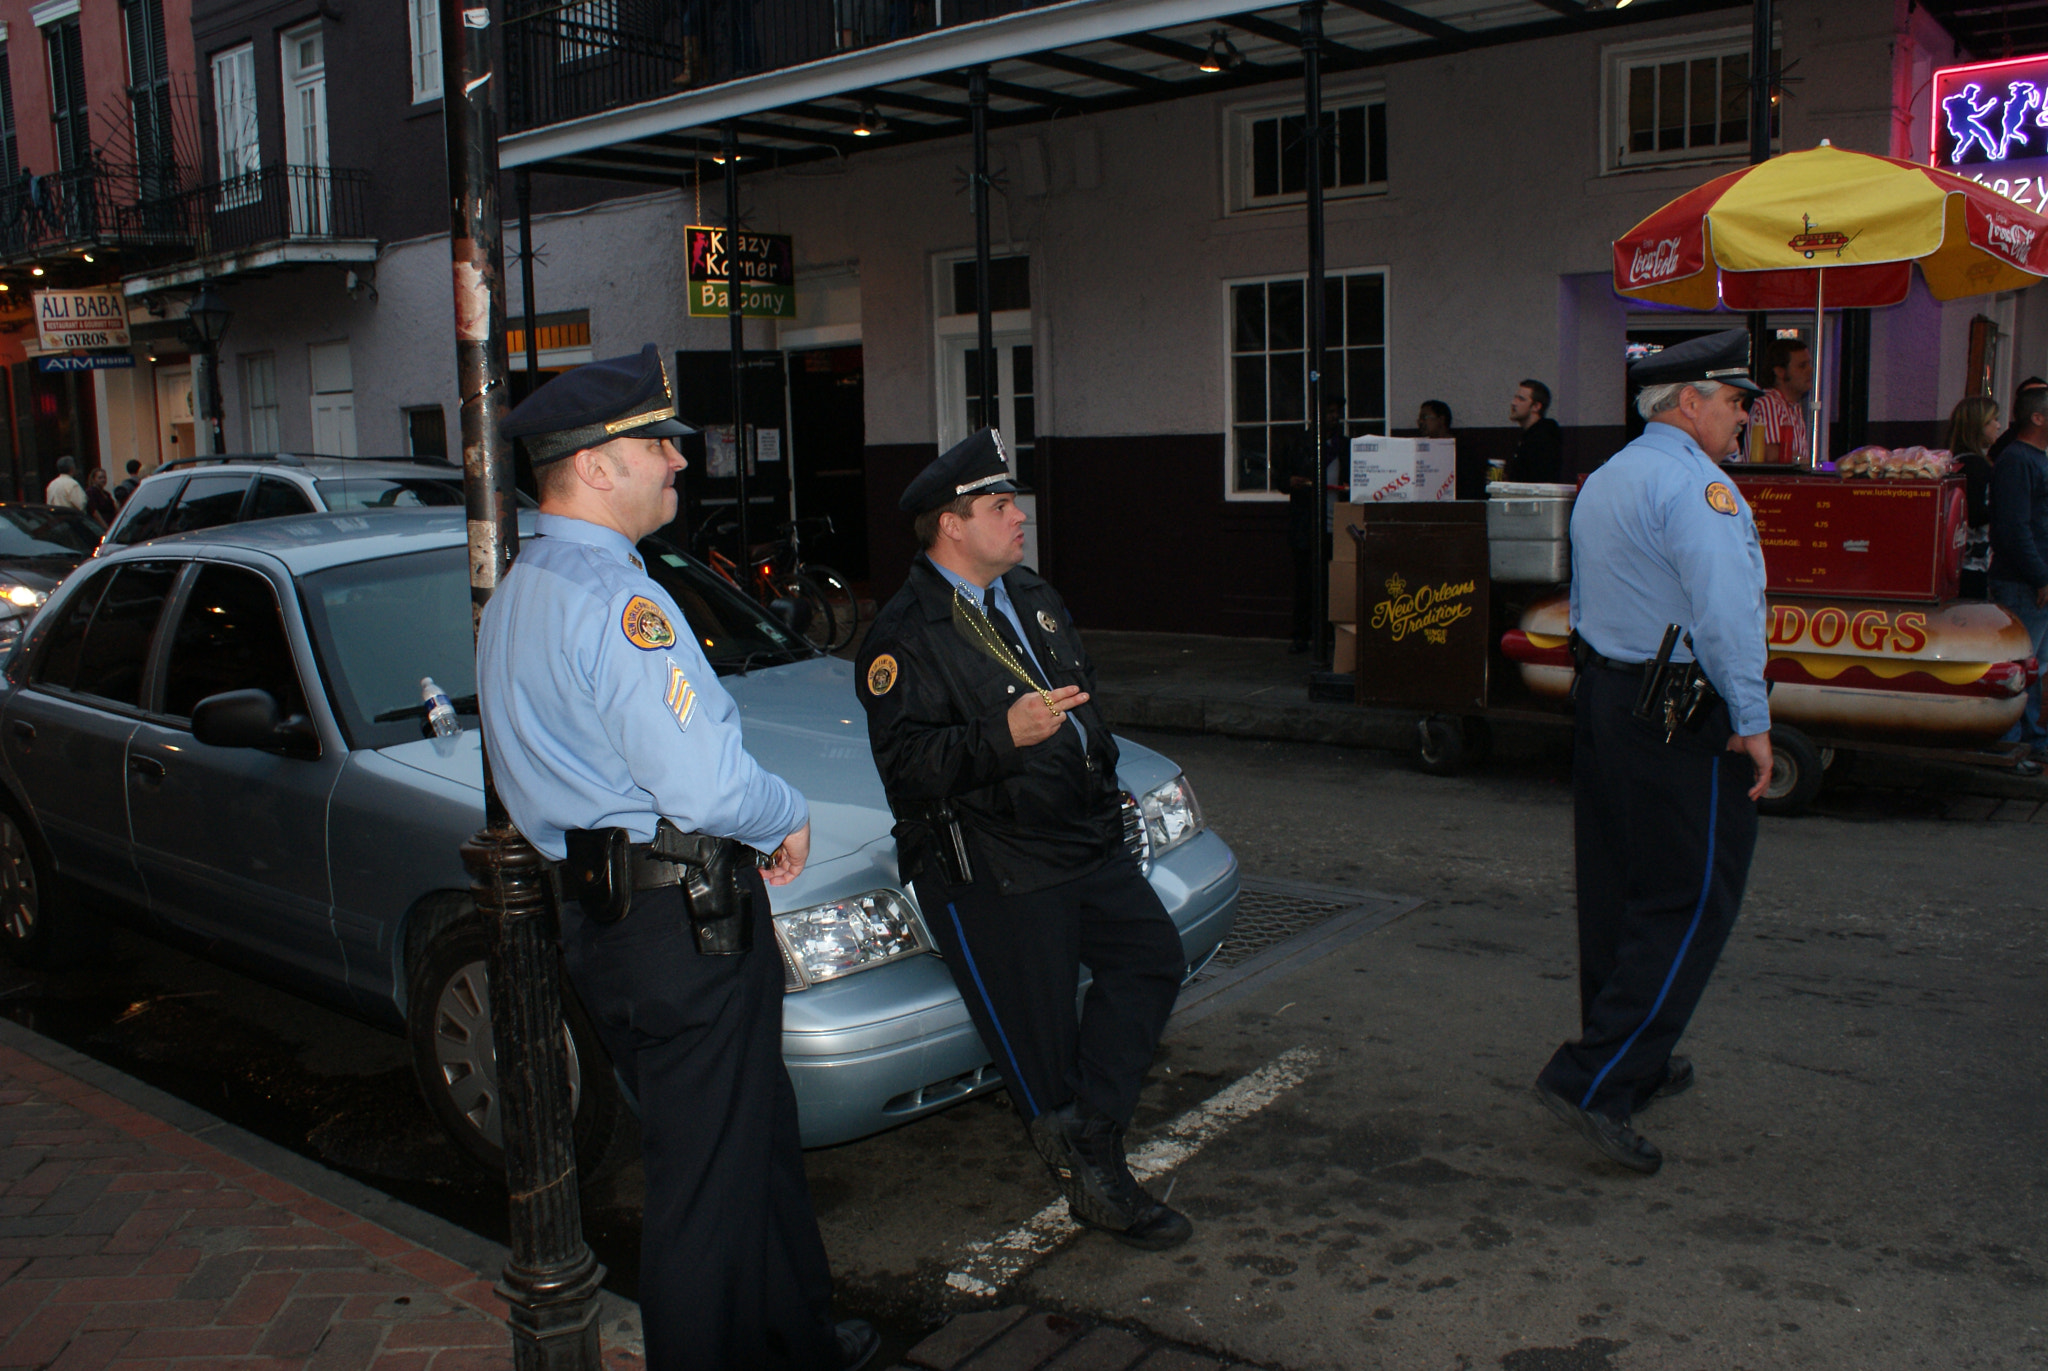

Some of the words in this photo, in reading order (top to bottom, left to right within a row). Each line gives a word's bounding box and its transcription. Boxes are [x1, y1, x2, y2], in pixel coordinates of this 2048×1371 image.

[710, 231, 771, 258] Kazy
[706, 252, 777, 278] Koner
[1629, 235, 1682, 284] Coca-Cola
[42, 296, 70, 318] ALI
[74, 295, 122, 317] BABA
[701, 285, 785, 314] Bacony
[64, 332, 109, 347] GYROS
[45, 357, 94, 370] ATM
[96, 357, 132, 365] INSIDE
[1373, 473, 1411, 501] SYSCO
[1753, 487, 1792, 500] Menu
[1852, 488, 1932, 499] www.luckydogs.us
[1371, 593, 1415, 630] New
[1414, 579, 1477, 613] Orleans
[1391, 602, 1473, 642] Tradition
[1768, 604, 1928, 653] DOGS
